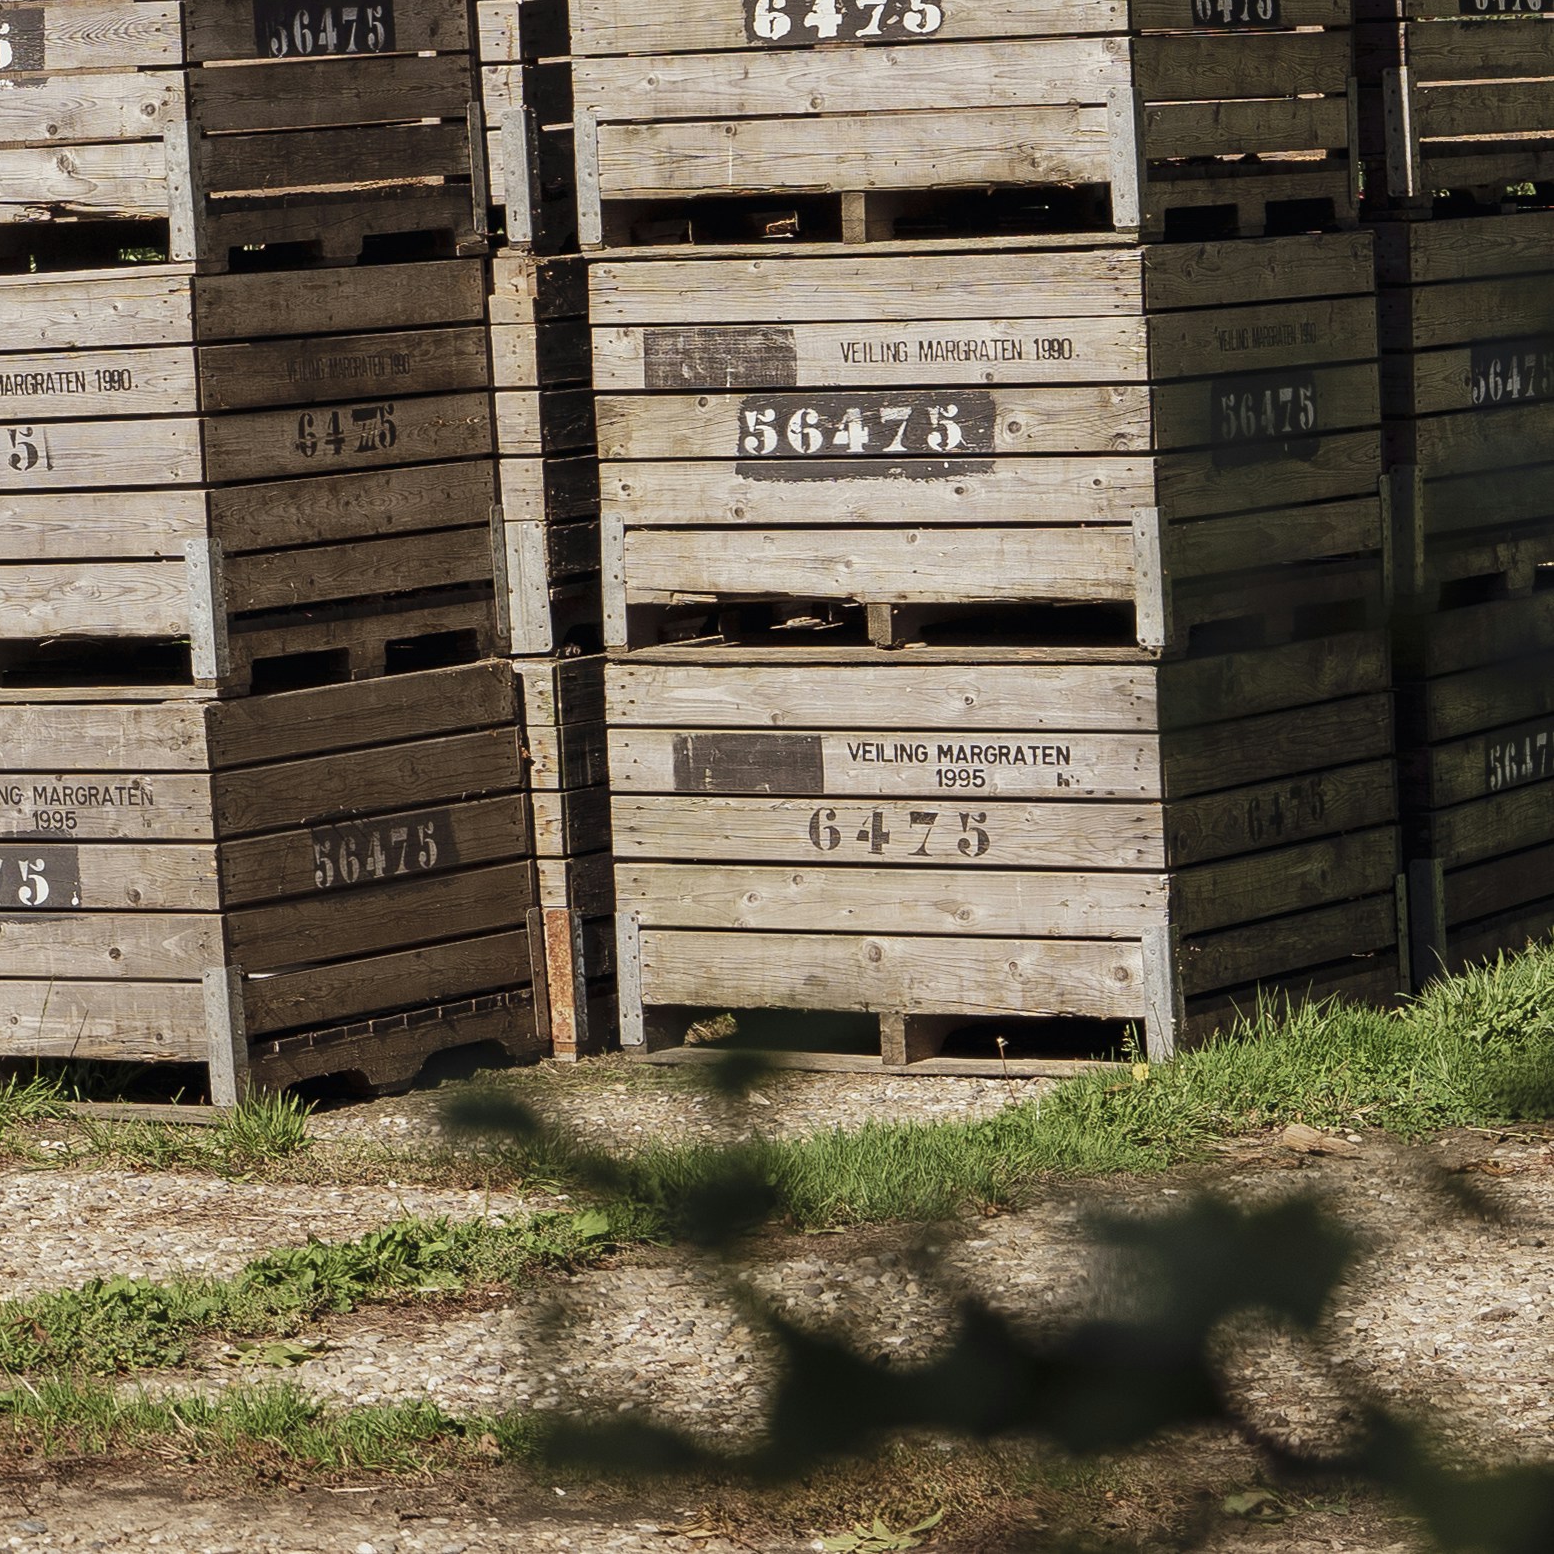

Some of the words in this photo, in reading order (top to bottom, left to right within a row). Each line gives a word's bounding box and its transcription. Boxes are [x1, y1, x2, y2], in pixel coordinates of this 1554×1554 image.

[265, 5, 386, 58] 56475
[841, 339, 908, 364] VEILING
[918, 339, 1023, 362] MARGRATEN
[296, 402, 397, 458] 6475
[744, 403, 964, 456] 56475
[1221, 383, 1315, 440] 56475
[847, 741, 929, 764] VEILING
[936, 744, 1072, 766] MARGRATEN
[935, 768, 986, 789] 1995
[1490, 730, 1554, 792] 5647
[31, 810, 78, 830] 1995
[32, 785, 155, 807] MARGRATEN
[313, 820, 439, 889] 56475
[809, 806, 991, 857] 6475
